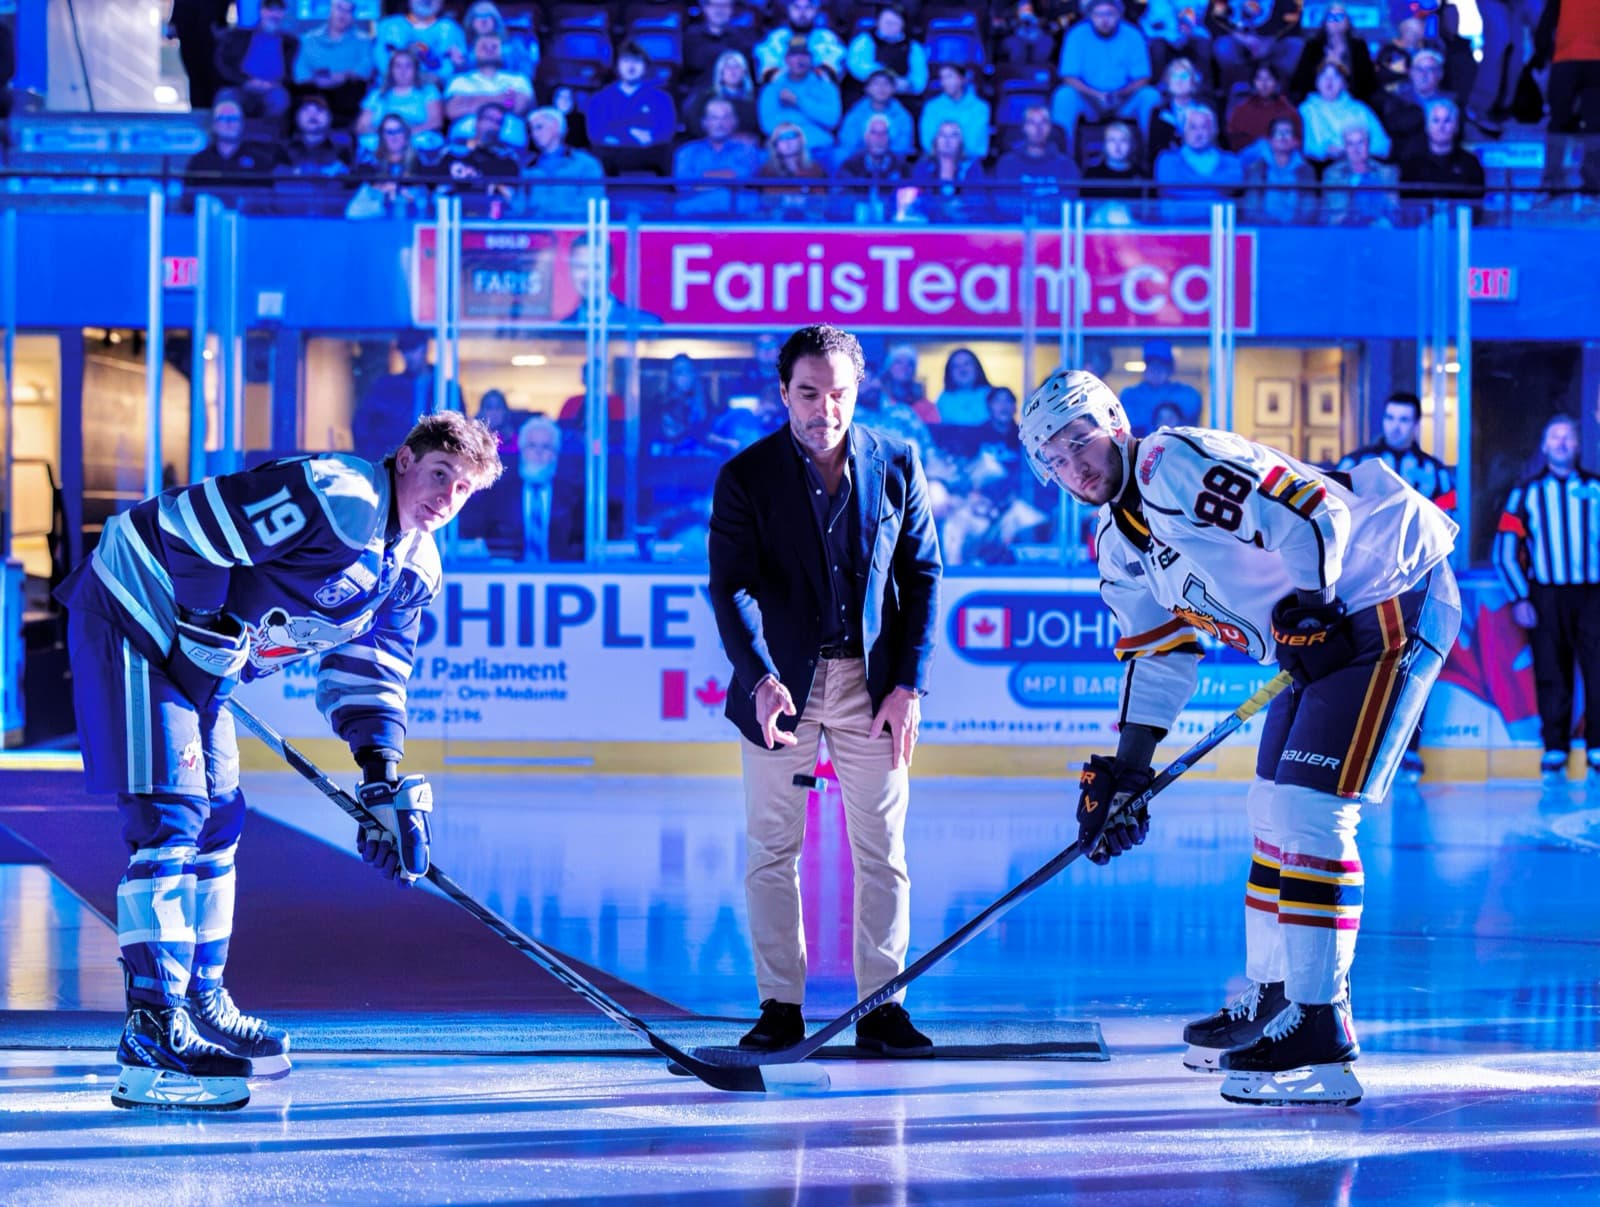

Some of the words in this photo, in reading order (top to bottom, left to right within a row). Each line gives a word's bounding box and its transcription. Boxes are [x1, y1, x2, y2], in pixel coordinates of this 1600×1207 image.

[671, 243, 1214, 315] FarisTeam.ca
[1468, 267, 1511, 298] EXIT
[241, 485, 307, 547] 19
[1194, 464, 1252, 532] 88
[432, 657, 567, 681] Parliament
